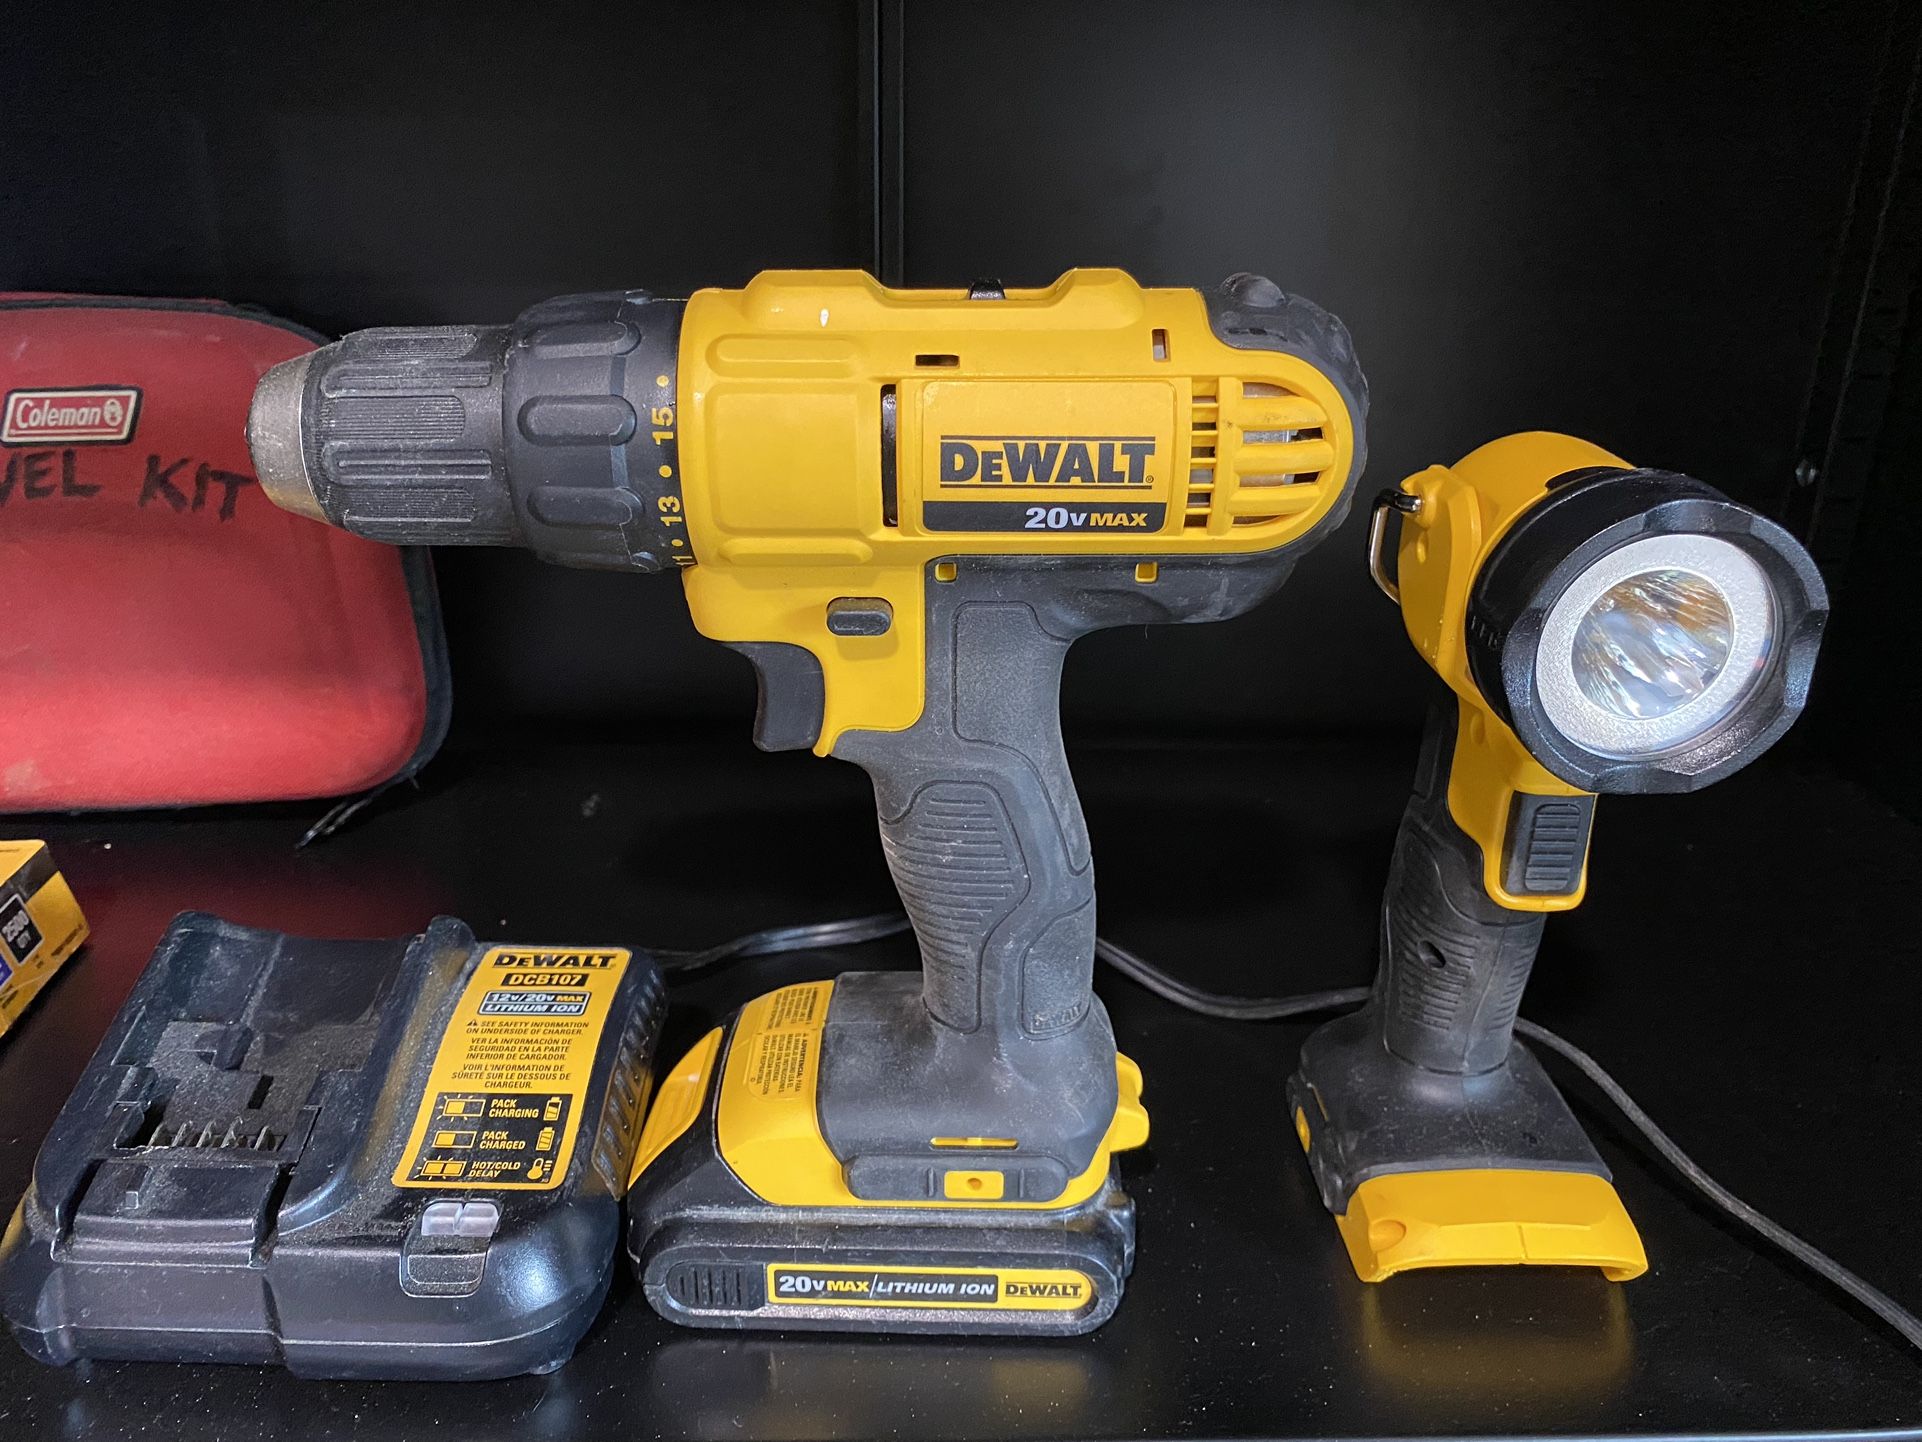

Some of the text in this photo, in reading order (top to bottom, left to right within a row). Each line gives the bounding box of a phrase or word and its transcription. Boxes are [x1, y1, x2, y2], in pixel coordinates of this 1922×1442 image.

[16, 399, 101, 429] Coleman
[652, 407, 674, 446] 15
[138, 454, 256, 522] KIT
[657, 495, 683, 527] 13
[1089, 512, 1148, 527] MAX
[508, 973, 582, 986] DCB107
[485, 1004, 580, 1012] LITHIUM ION
[500, 1037, 560, 1045] INFORMACIÓN
[468, 1045, 517, 1053] SEGURIDAD
[465, 1052, 504, 1060] INFERIOR
[463, 1063, 484, 1071] VOIR
[485, 1064, 552, 1072] L'INFORMATION
[486, 1072, 504, 1080] SUR
[505, 1072, 516, 1080] LE
[484, 1081, 533, 1089] CHARGEUR.
[490, 1099, 517, 1108] PACK
[488, 1108, 540, 1118] CHARGING
[481, 1131, 509, 1140] PACK
[479, 1140, 526, 1150] CHARGED
[471, 1161, 521, 1170] HOT/COLD
[468, 1169, 502, 1178] DELAY
[959, 1282, 995, 1296] ION
